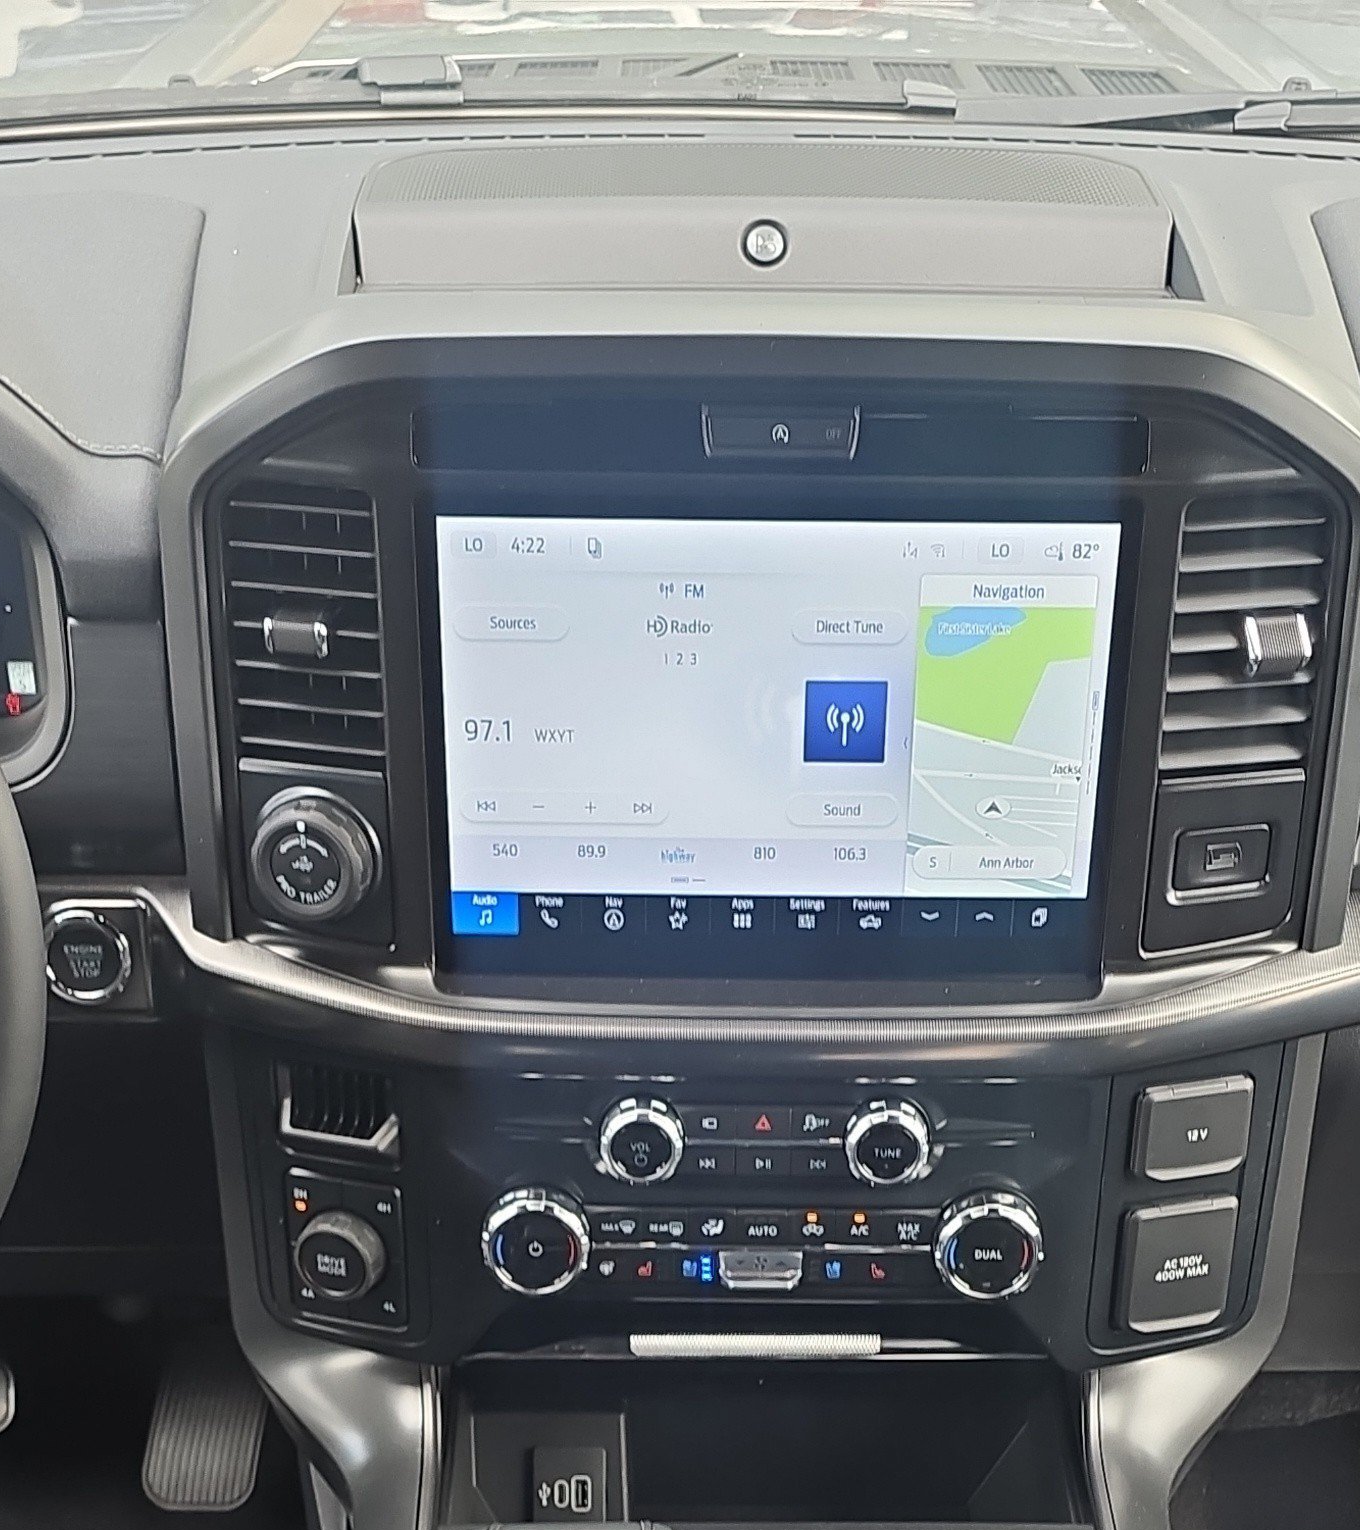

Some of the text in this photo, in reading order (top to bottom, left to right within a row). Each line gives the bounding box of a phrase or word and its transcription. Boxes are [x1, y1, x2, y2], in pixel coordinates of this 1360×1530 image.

[464, 537, 483, 553] LO
[511, 537, 546, 554] 4:22
[991, 543, 1010, 559] LO
[1072, 543, 1100, 559] 82°
[685, 583, 704, 599] FM
[973, 584, 1045, 601] Navigation
[490, 616, 536, 630] Sources
[671, 618, 712, 635] Radio
[816, 620, 884, 635] Direct Tune
[676, 653, 684, 665] 2
[690, 653, 698, 665] 3
[464, 719, 575, 743] 97.1 WXYT
[823, 803, 862, 817] Sound
[493, 843, 518, 857] 540
[577, 844, 606, 859] 89.9
[753, 847, 776, 860] 810
[833, 847, 867, 861] 106.3
[929, 857, 937, 869] S
[978, 857, 1035, 870] Ann Arbor
[276, 874, 337, 905] PRO TRAILER
[472, 894, 497, 906] Audio
[535, 895, 564, 908] Phone
[605, 896, 623, 908] Nav
[670, 896, 687, 909] Fav
[731, 897, 754, 911] Apps
[789, 898, 825, 912] Settings
[853, 898, 890, 912] Features
[630, 1141, 651, 1152] VOL
[874, 1148, 902, 1158] TUNE
[748, 1225, 778, 1236] AUTO
[850, 1225, 869, 1236] A/C
[897, 1222, 921, 1233] MAX
[899, 1231, 918, 1241] A/C
[974, 1249, 1003, 1261] DUAL
[1155, 1263, 1209, 1282] 400W MAX
